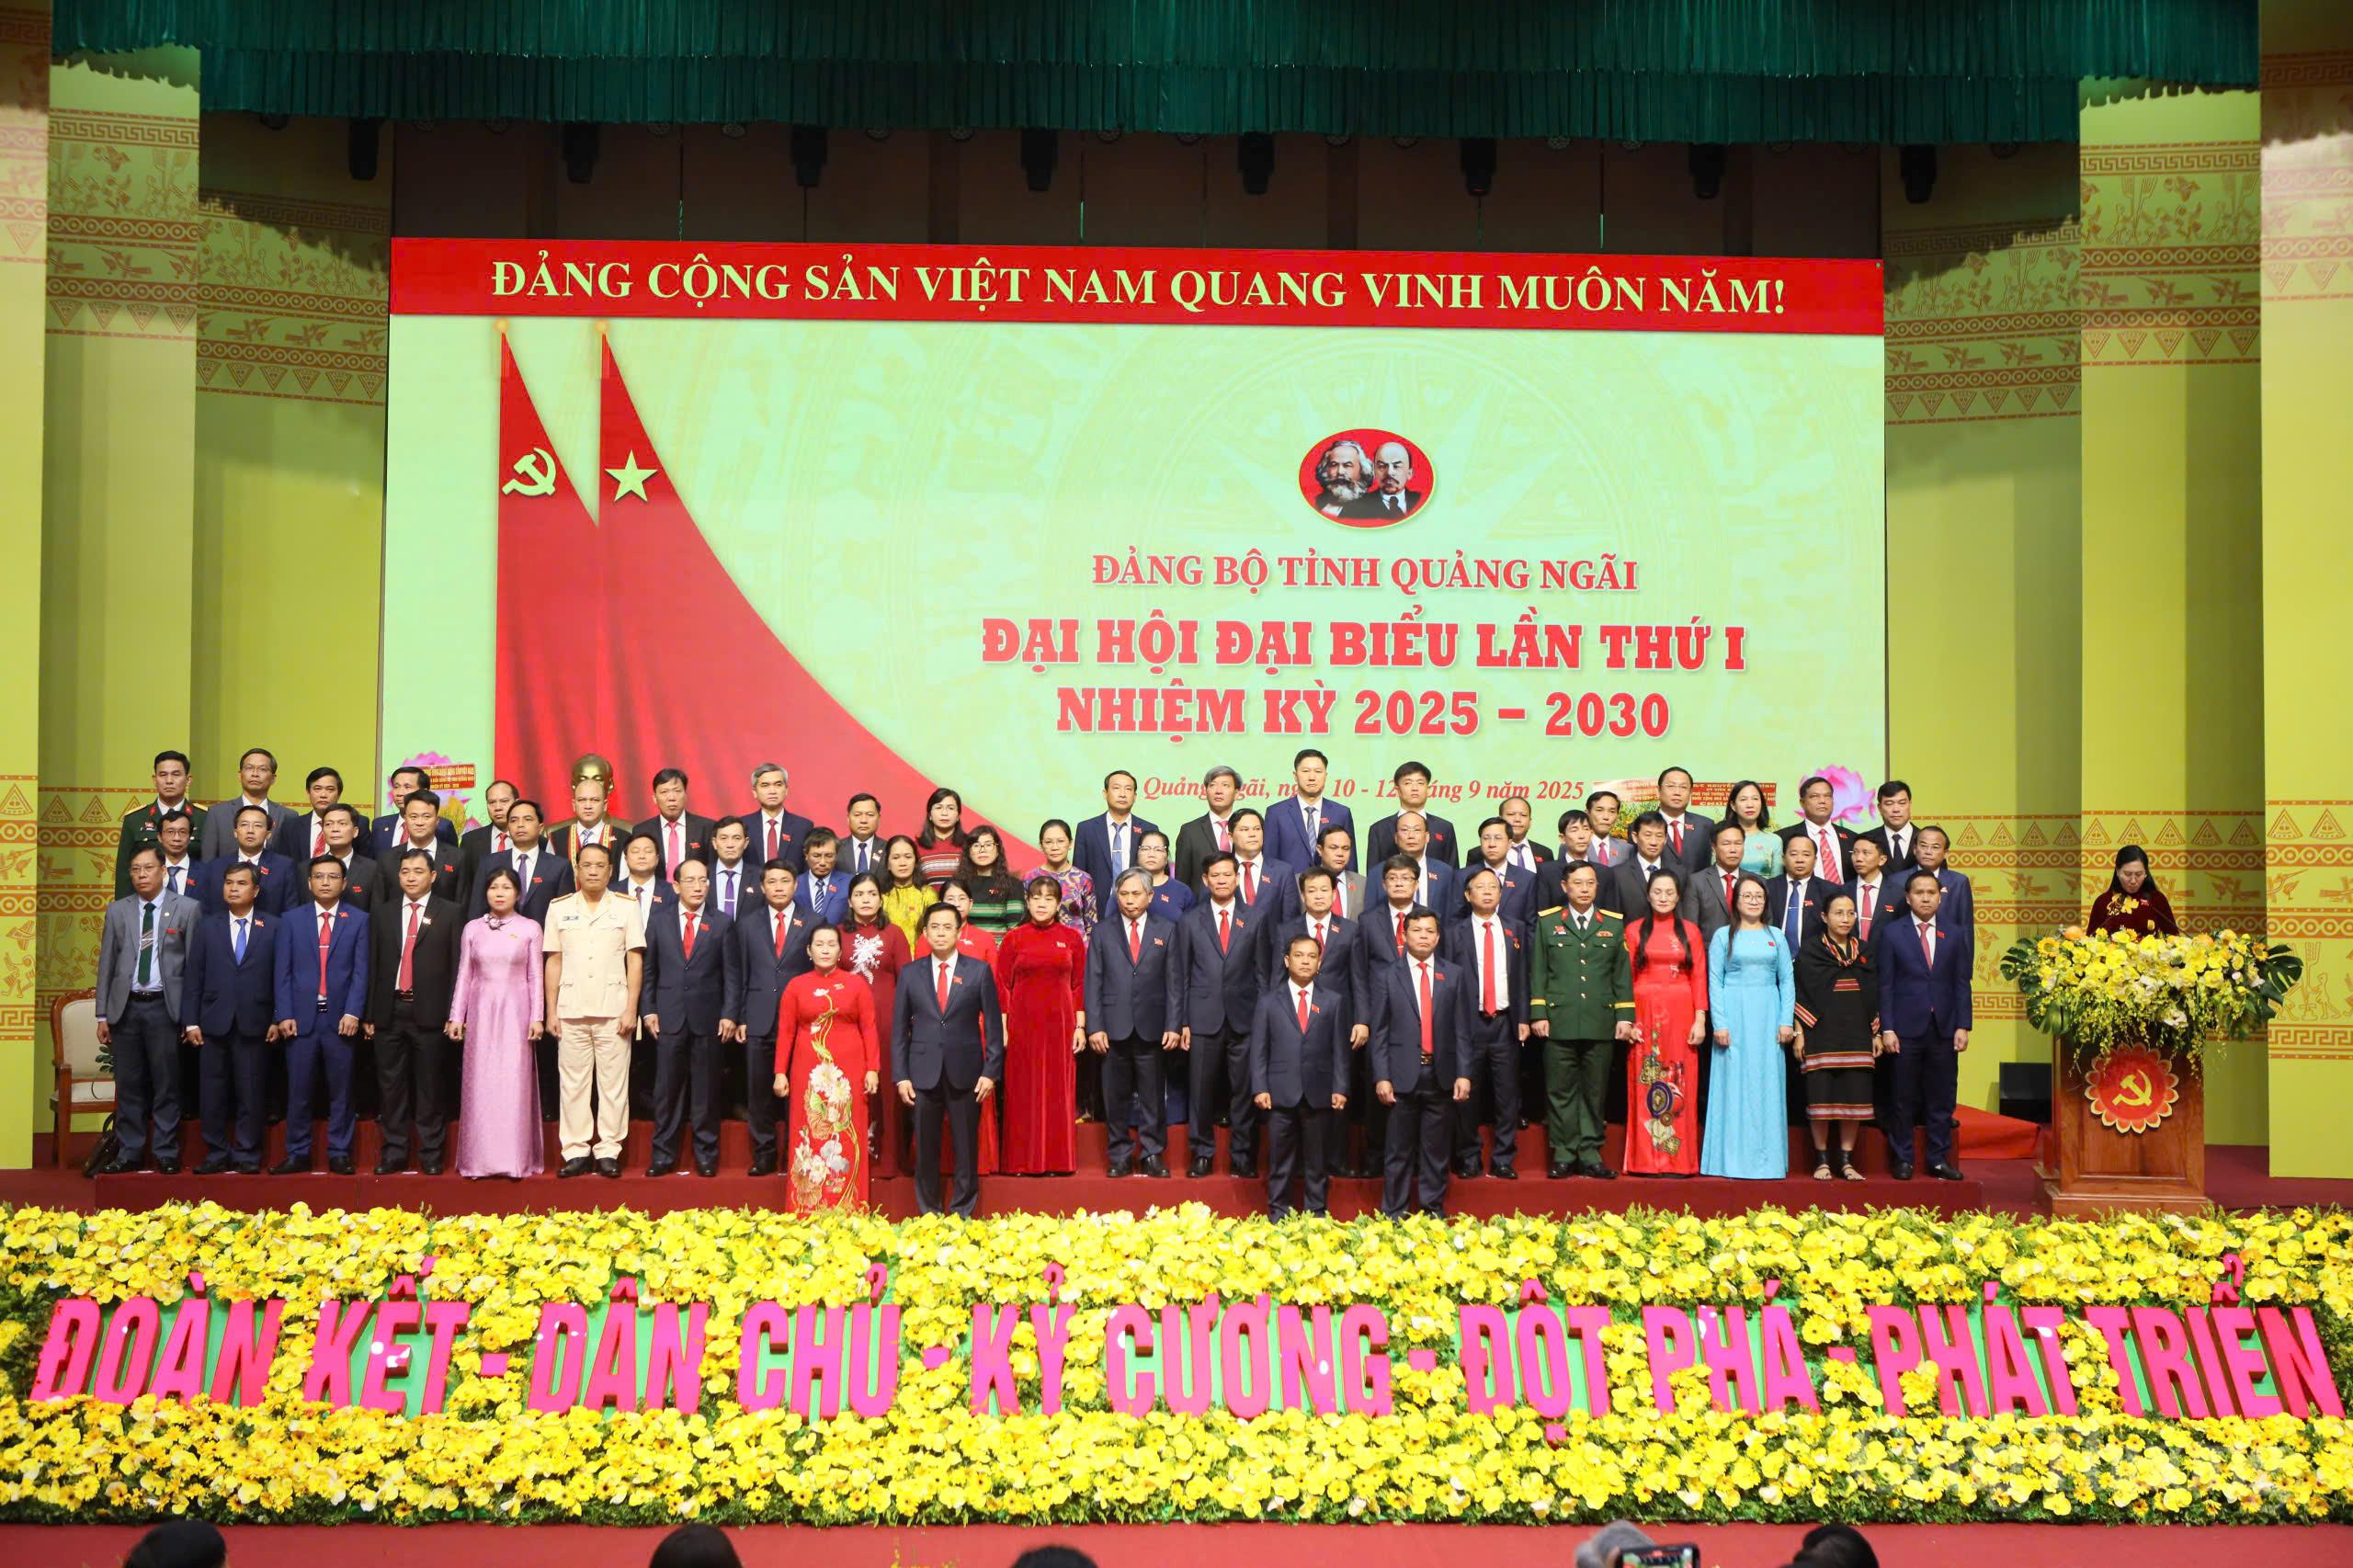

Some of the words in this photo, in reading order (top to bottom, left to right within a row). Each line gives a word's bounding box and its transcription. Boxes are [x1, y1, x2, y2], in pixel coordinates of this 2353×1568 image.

[491, 250, 633, 298] ĐẢNG
[648, 253, 790, 308] CỘNG
[804, 254, 900, 301] SẢN
[914, 256, 1030, 312] VIỆT
[1044, 268, 1157, 304] NAM
[1170, 270, 1347, 312] QUANG
[1360, 273, 1483, 309] VINH
[1497, 266, 1646, 312] MUÔN
[1660, 268, 1784, 314] NĂM!
[1092, 546, 1203, 585] ĐẢNG
[1213, 548, 1268, 595] BỘ
[1277, 548, 1381, 587] TỈNH
[1391, 550, 1530, 596] QUẢNG
[1540, 553, 1638, 590] NGÃI
[983, 619, 1080, 673] ĐẠI
[1097, 609, 1199, 675] HỘI
[1215, 620, 1313, 676] ĐẠI
[1329, 605, 1459, 667] BIỂU
[1476, 607, 1583, 668] LẦN
[1599, 616, 1711, 670] THỨ
[1724, 626, 1745, 670] I
[1057, 677, 1245, 743] NHIỆM
[1264, 679, 1336, 734] KỲ
[1355, 689, 1479, 736] 2025
[1545, 691, 1669, 737] 2030
[1236, 779, 1269, 801] gãi,
[1333, 778, 1356, 798] 10
[1375, 778, 1396, 798] 12
[1428, 779, 1463, 802] áng
[1469, 779, 1483, 799] 9
[1485, 781, 1529, 799] năm
[1536, 780, 1584, 800] 2025
[29, 1272, 286, 1408] ĐOÀN
[303, 1256, 472, 1415] KẾT
[527, 1277, 709, 1416] DÂN
[737, 1262, 902, 1420] CHỦ
[970, 1261, 1077, 1417] KỶ
[1104, 1292, 1394, 1419] CƯƠNG
[1458, 1278, 1613, 1449] ĐỘT
[1642, 1278, 1822, 1418] PHÁ
[1864, 1281, 2080, 1419] PHÁT
[2083, 1253, 2347, 1420] TRIỂN
